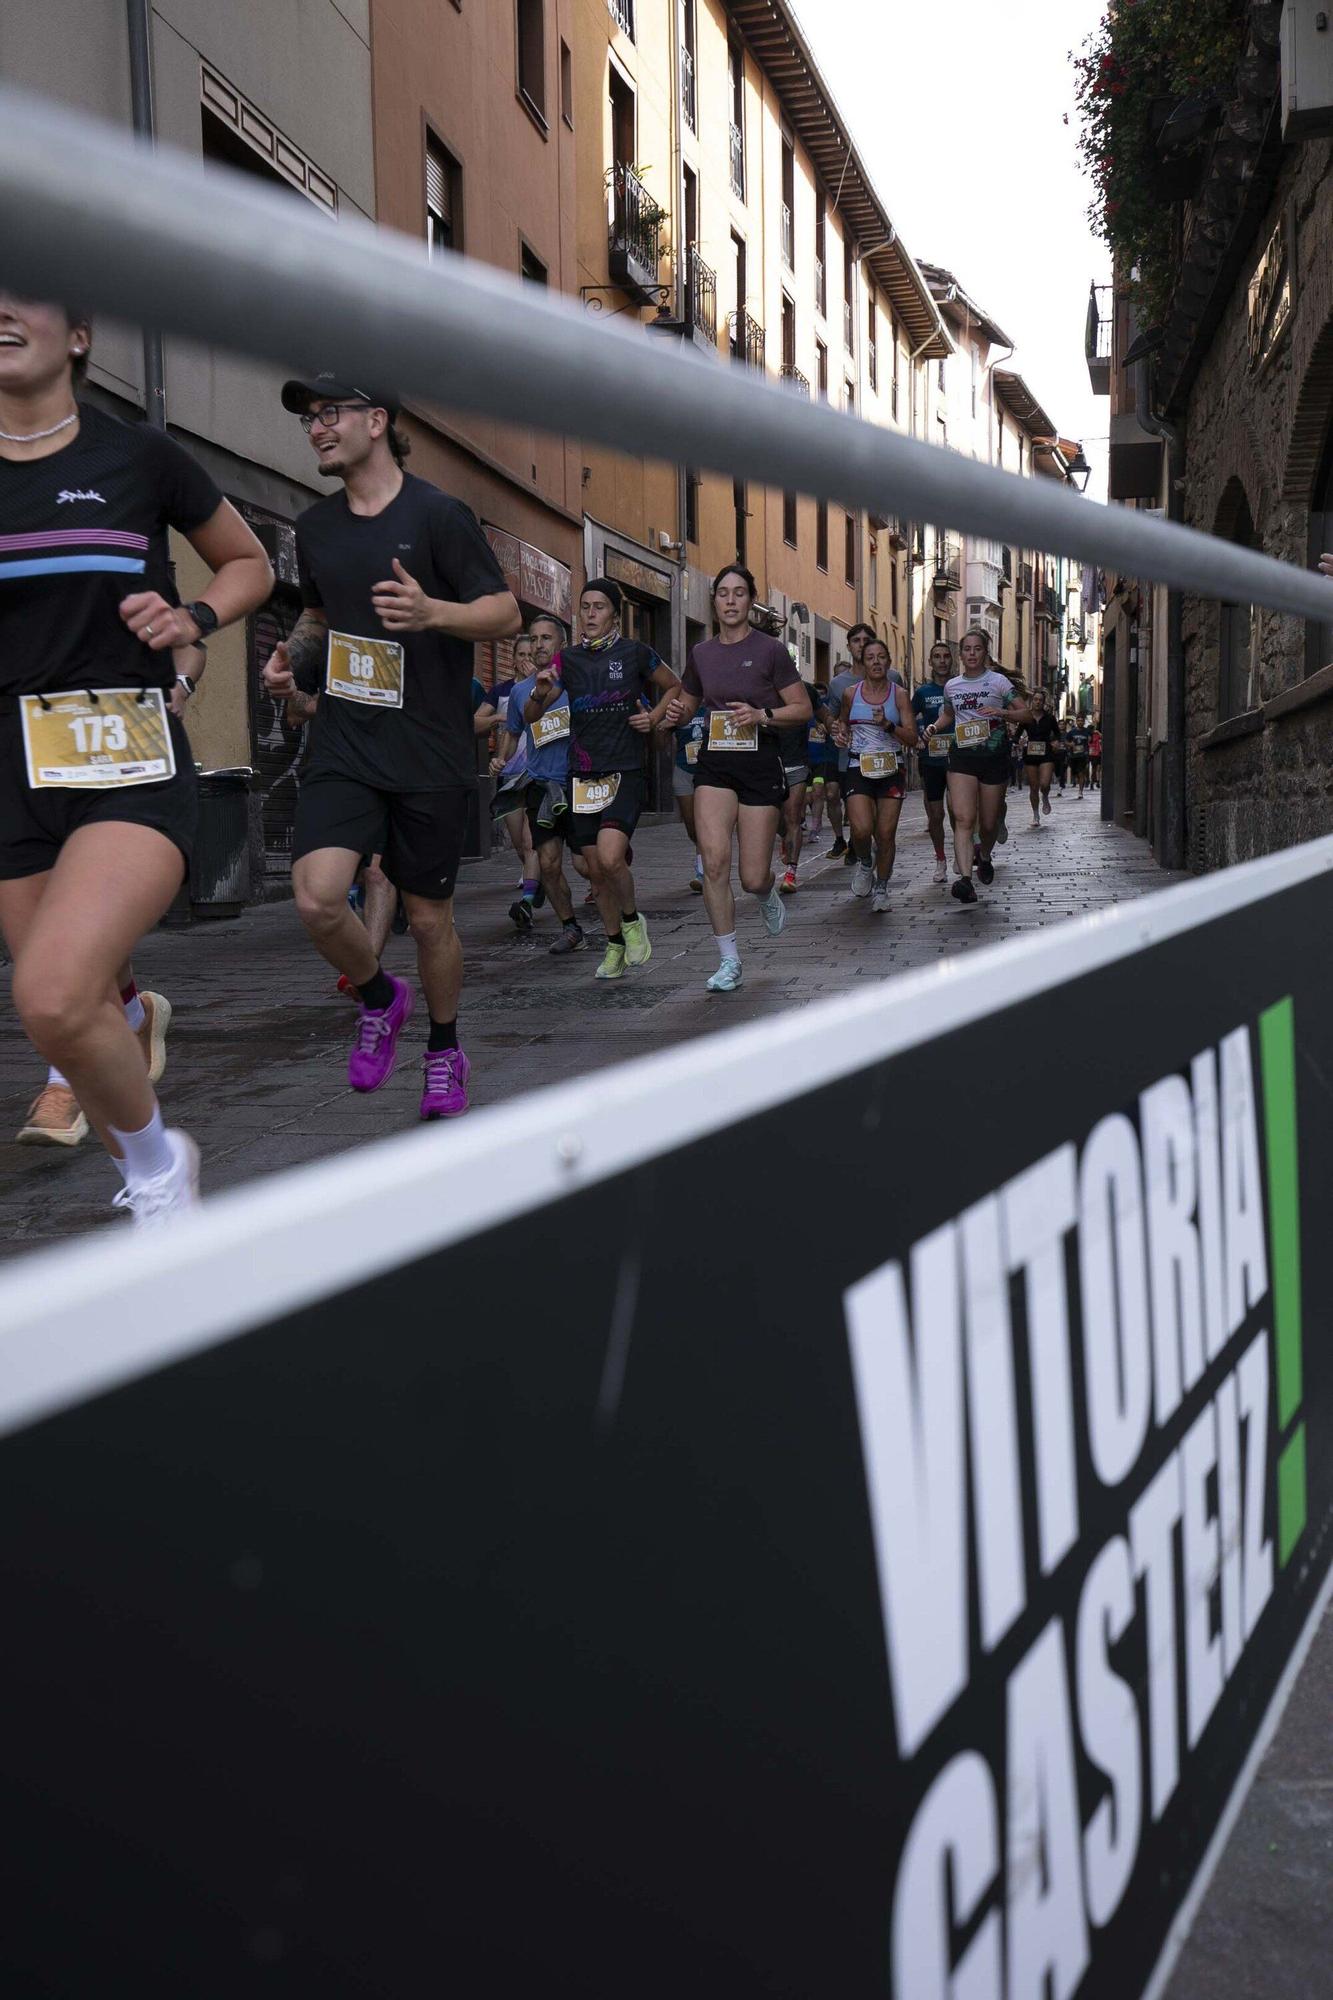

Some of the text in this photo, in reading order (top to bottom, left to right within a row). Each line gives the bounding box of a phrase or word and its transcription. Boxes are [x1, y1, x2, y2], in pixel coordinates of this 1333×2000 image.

[349, 652, 375, 680] 88
[68, 714, 128, 753] 173
[541, 716, 561, 732] 260
[964, 725, 980, 737] 670
[586, 784, 610, 800] 498
[842, 1024, 1269, 1761] VITORIA
[890, 1328, 1275, 2000] GASTEIZ
